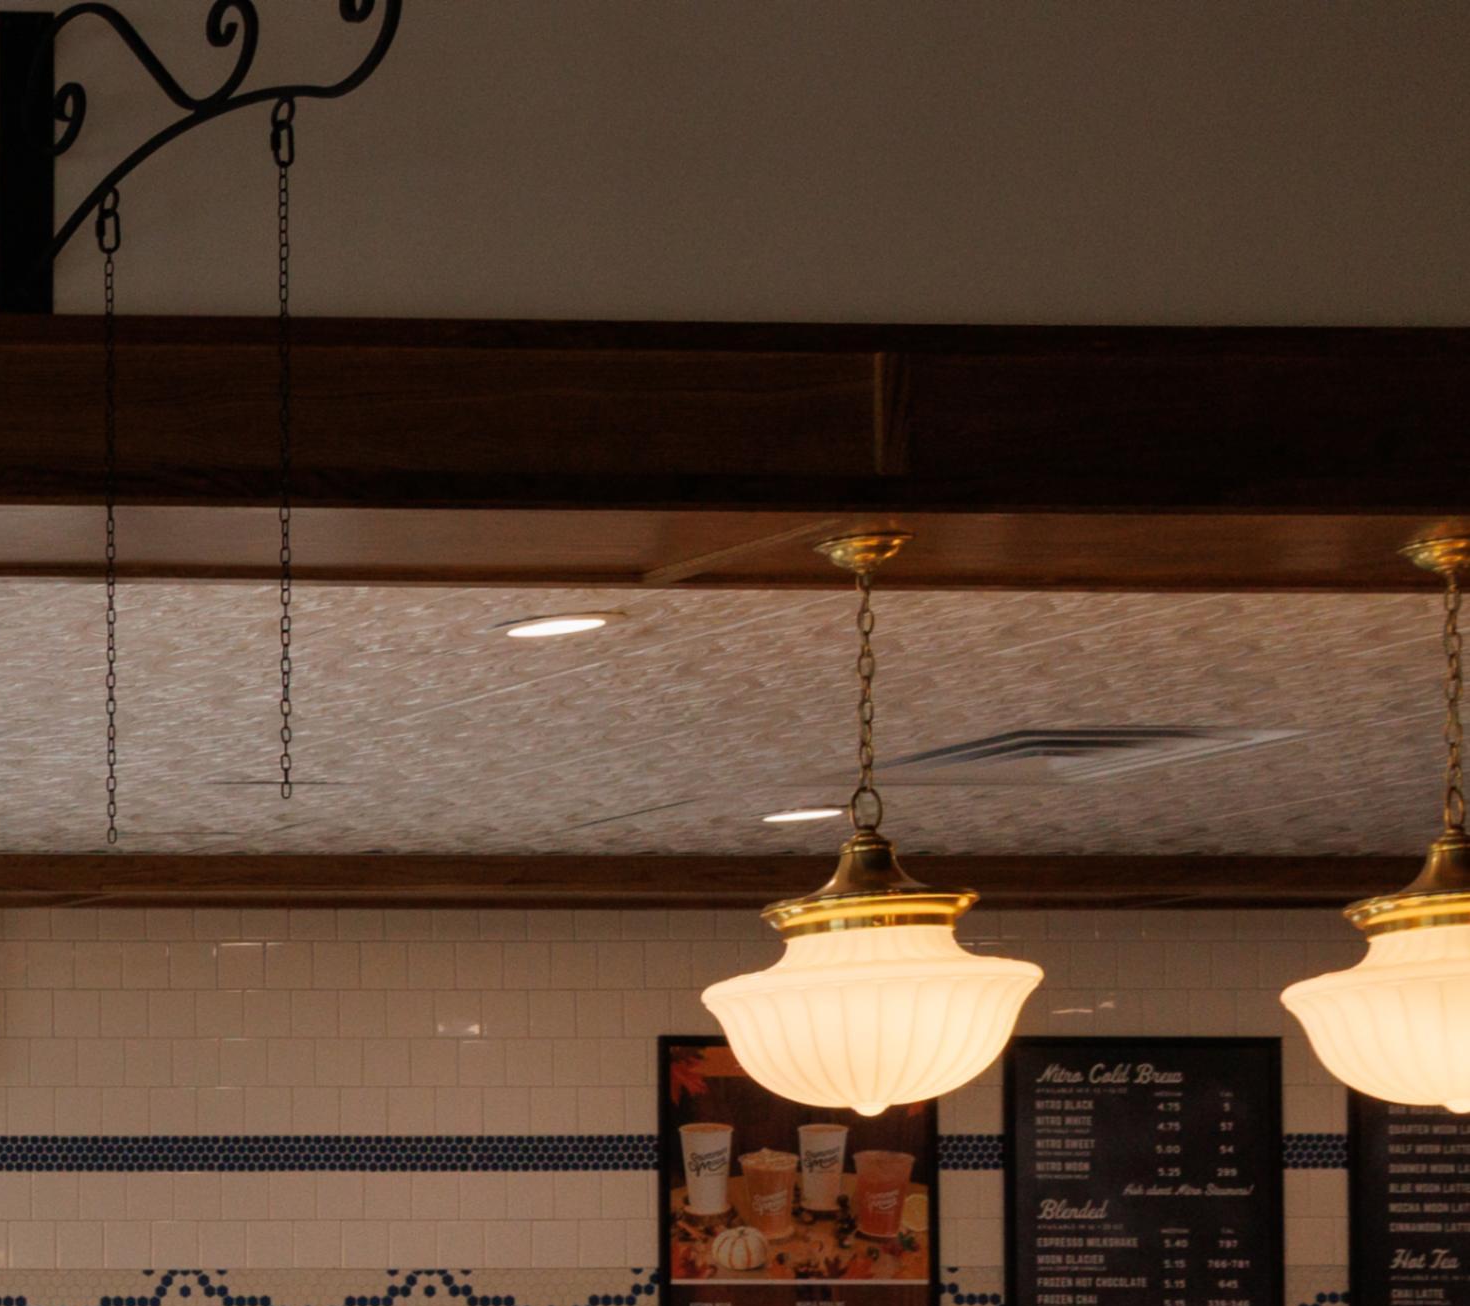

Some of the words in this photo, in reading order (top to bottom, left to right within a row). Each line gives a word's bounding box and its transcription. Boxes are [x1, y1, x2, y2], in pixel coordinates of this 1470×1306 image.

[1035, 1063, 1084, 1083] Nitro
[1088, 1063, 1130, 1084] Cold
[1133, 1063, 1183, 1084] Brew
[1037, 1199, 1107, 1220] Blended
[1390, 1249, 1426, 1269] Hot
[1430, 1249, 1460, 1269] Tea
